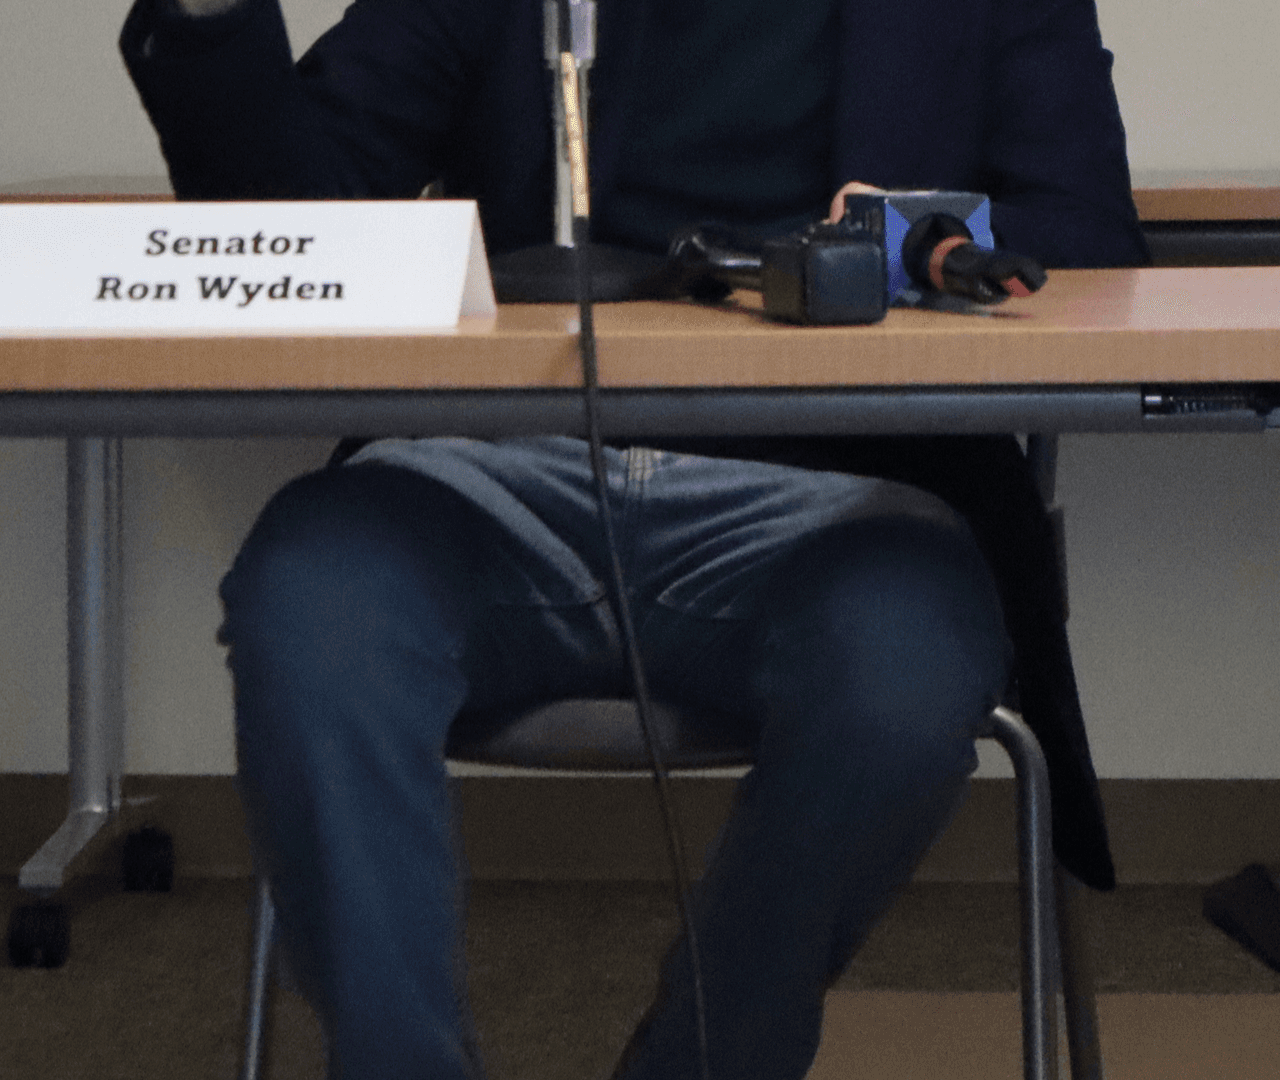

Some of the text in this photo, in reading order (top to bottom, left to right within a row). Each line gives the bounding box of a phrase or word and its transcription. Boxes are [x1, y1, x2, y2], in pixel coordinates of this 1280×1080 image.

[145, 230, 315, 255] Senator
[95, 276, 345, 307] Ron Wyden
